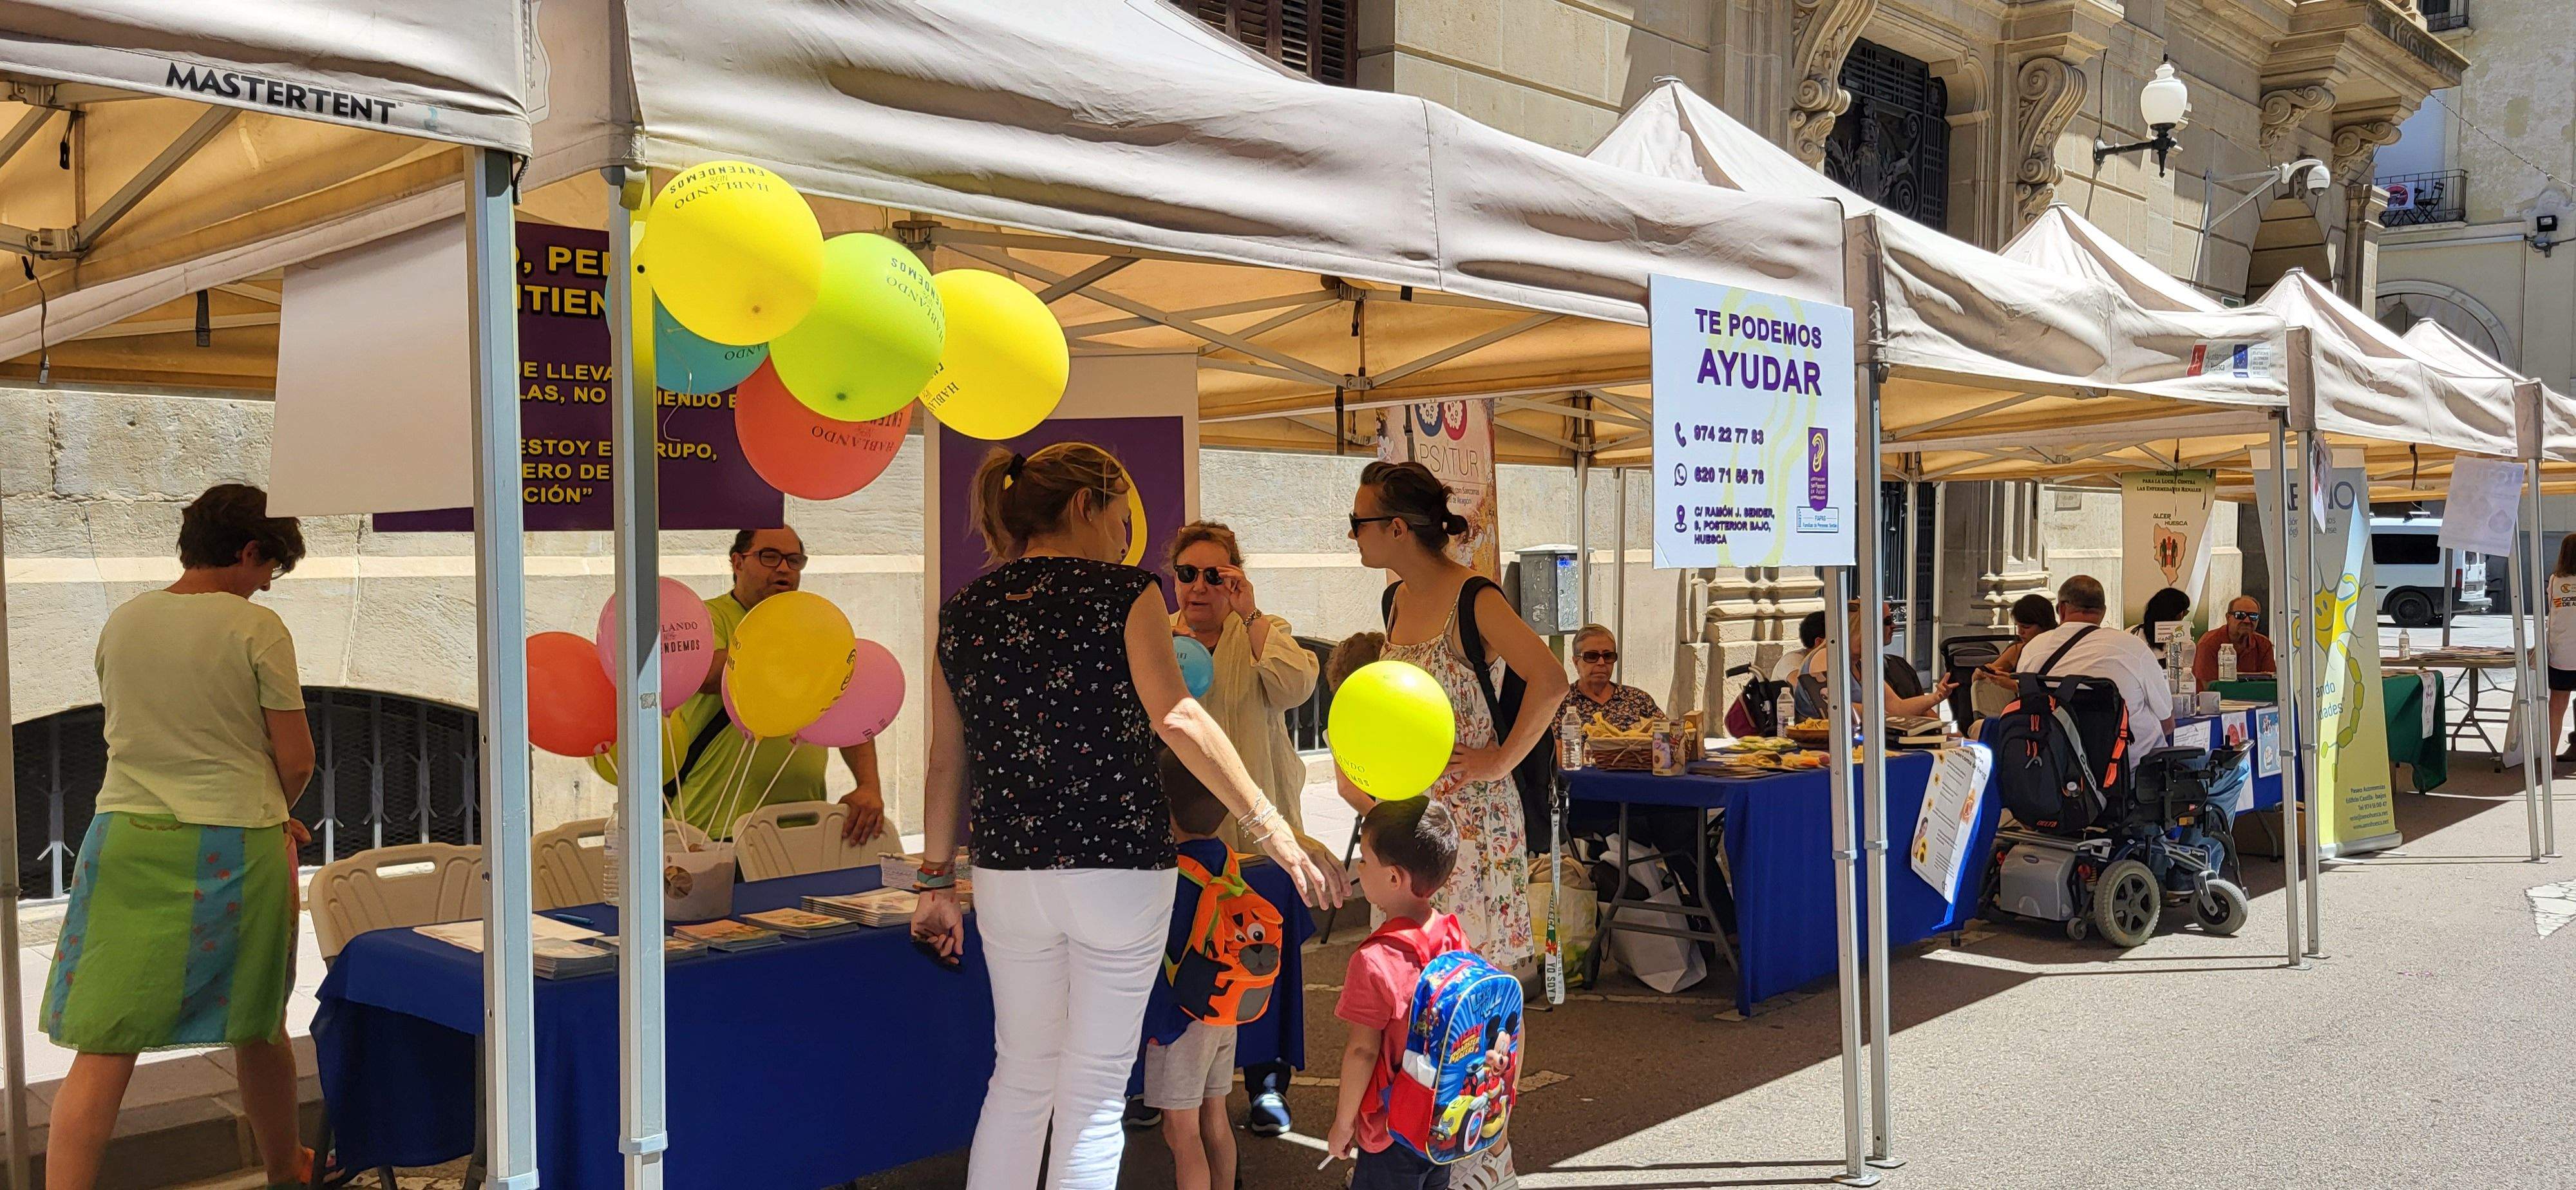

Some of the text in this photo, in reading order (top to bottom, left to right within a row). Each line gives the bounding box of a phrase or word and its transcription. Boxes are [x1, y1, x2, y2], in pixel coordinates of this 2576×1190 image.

[166, 62, 396, 125] MASTERTENT
[674, 182, 770, 209] HABLANDO
[1694, 308, 1822, 349] TE PODEMOS
[1697, 348, 1822, 396] AYUDAR
[574, 386, 606, 403] NO
[1718, 426, 1732, 443] 22
[1734, 428, 1748, 444] 77
[1718, 467, 1732, 484] 71
[1705, 505, 1734, 518] RAMÓN
[1735, 507, 1742, 518] J.
[1694, 534, 1727, 545] HUESCA
